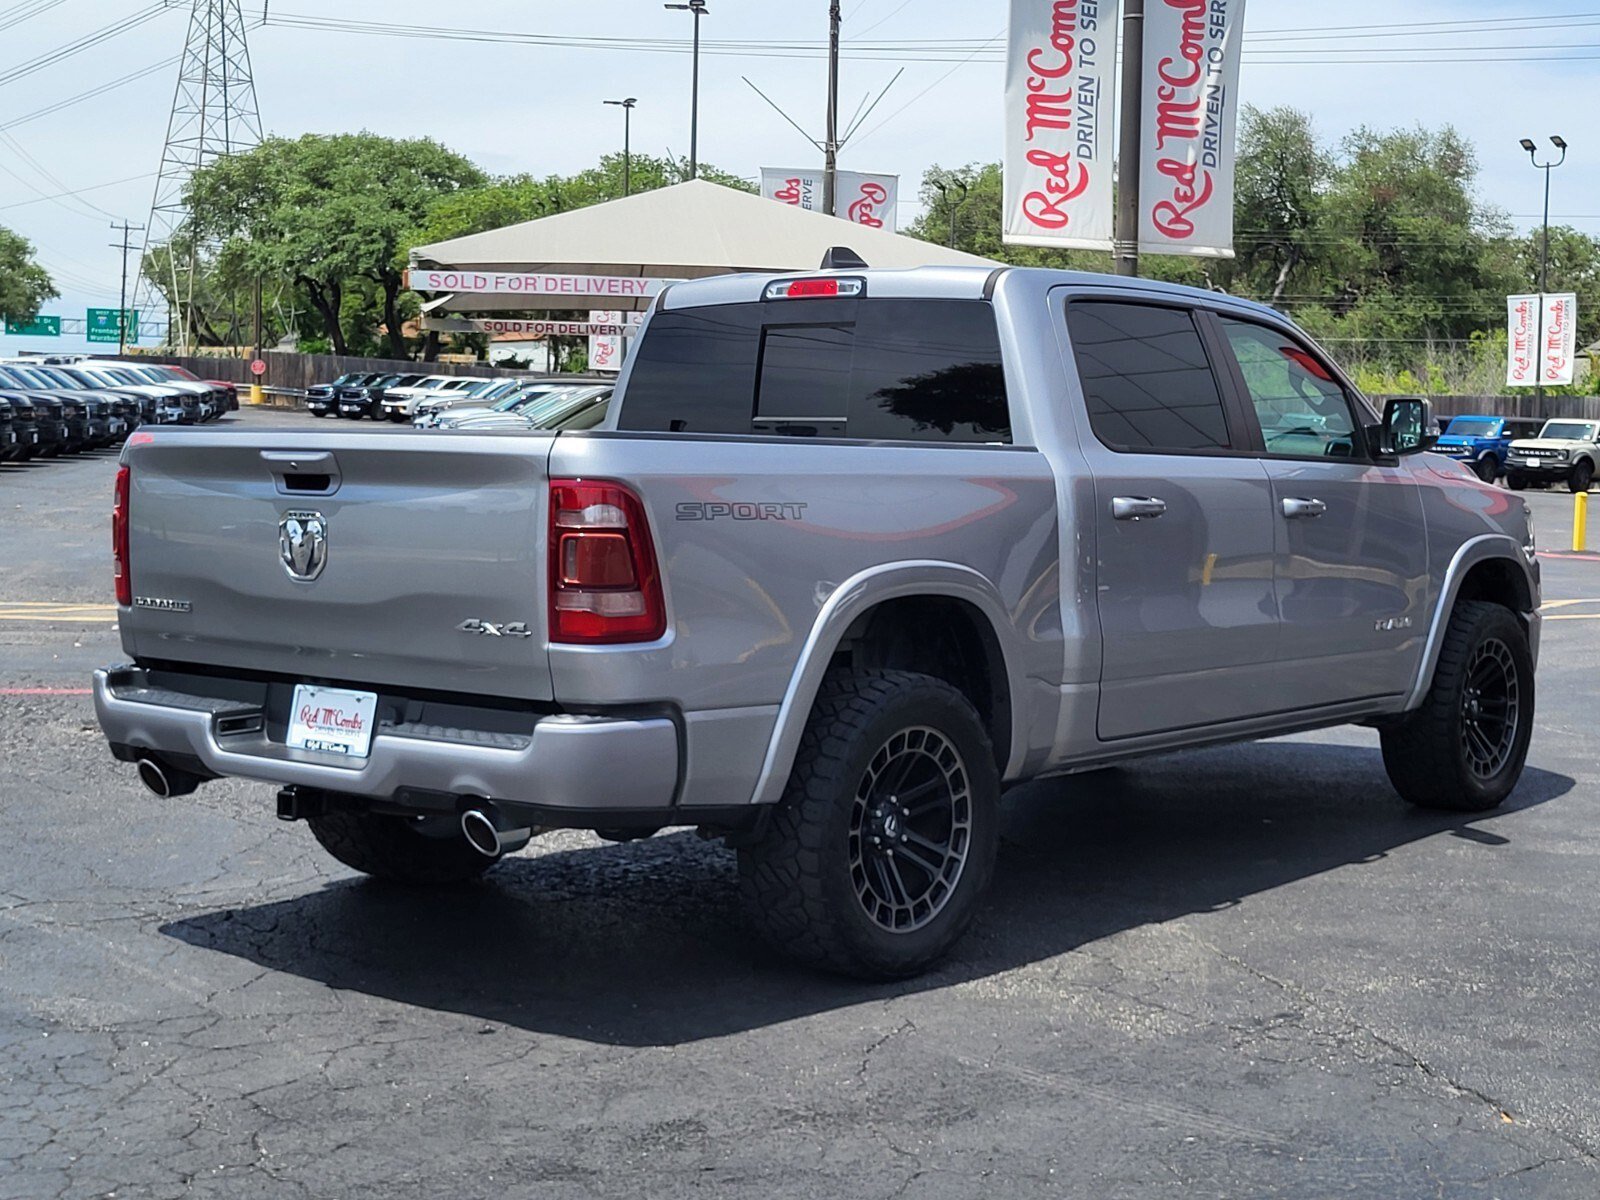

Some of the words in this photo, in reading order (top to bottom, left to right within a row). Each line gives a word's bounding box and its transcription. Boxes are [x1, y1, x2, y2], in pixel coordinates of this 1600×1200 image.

[1080, 0, 1098, 32] SE
[1079, 37, 1096, 68] TO
[1207, 47, 1224, 77] TO
[1078, 76, 1096, 160] DRIVEN
[1202, 85, 1221, 169] DRIVEN
[1022, 150, 1089, 229] Red
[1152, 158, 1213, 239] Red
[429, 273, 487, 290] SOLD
[494, 276, 538, 291] FOR
[545, 277, 649, 295] DELIVERY
[484, 321, 522, 333] SOLD
[526, 322, 554, 334] FOR
[558, 323, 627, 335] DELIVERY
[675, 502, 808, 521] SPORT
[301, 705, 320, 729] Red
[322, 707, 363, 729] McCombs
